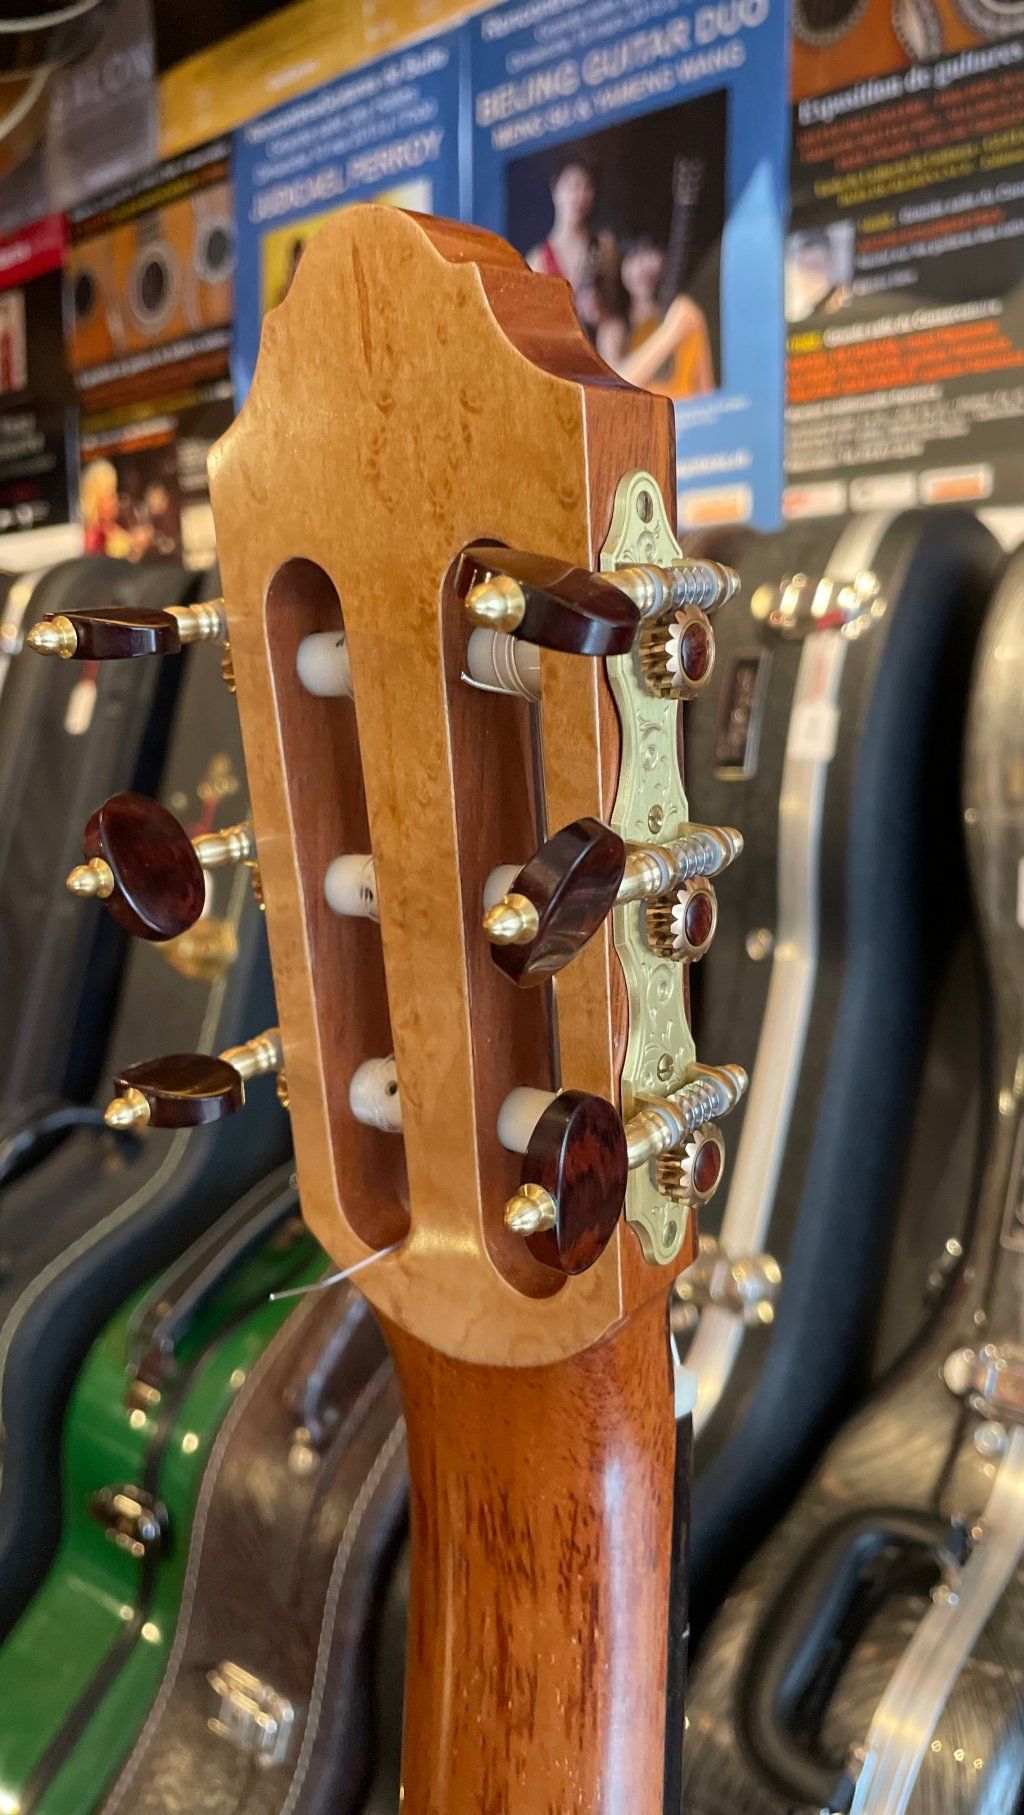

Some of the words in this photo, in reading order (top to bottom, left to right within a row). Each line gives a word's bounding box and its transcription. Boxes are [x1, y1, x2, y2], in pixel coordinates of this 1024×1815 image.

[475, 58, 581, 128] BEIJING
[582, 16, 691, 86] GUITAR
[694, 0, 769, 45] DUO
[676, 38, 747, 84] WANG
[798, 75, 904, 126] Exposition
[904, 65, 933, 93] de
[934, 43, 1024, 89] guitares
